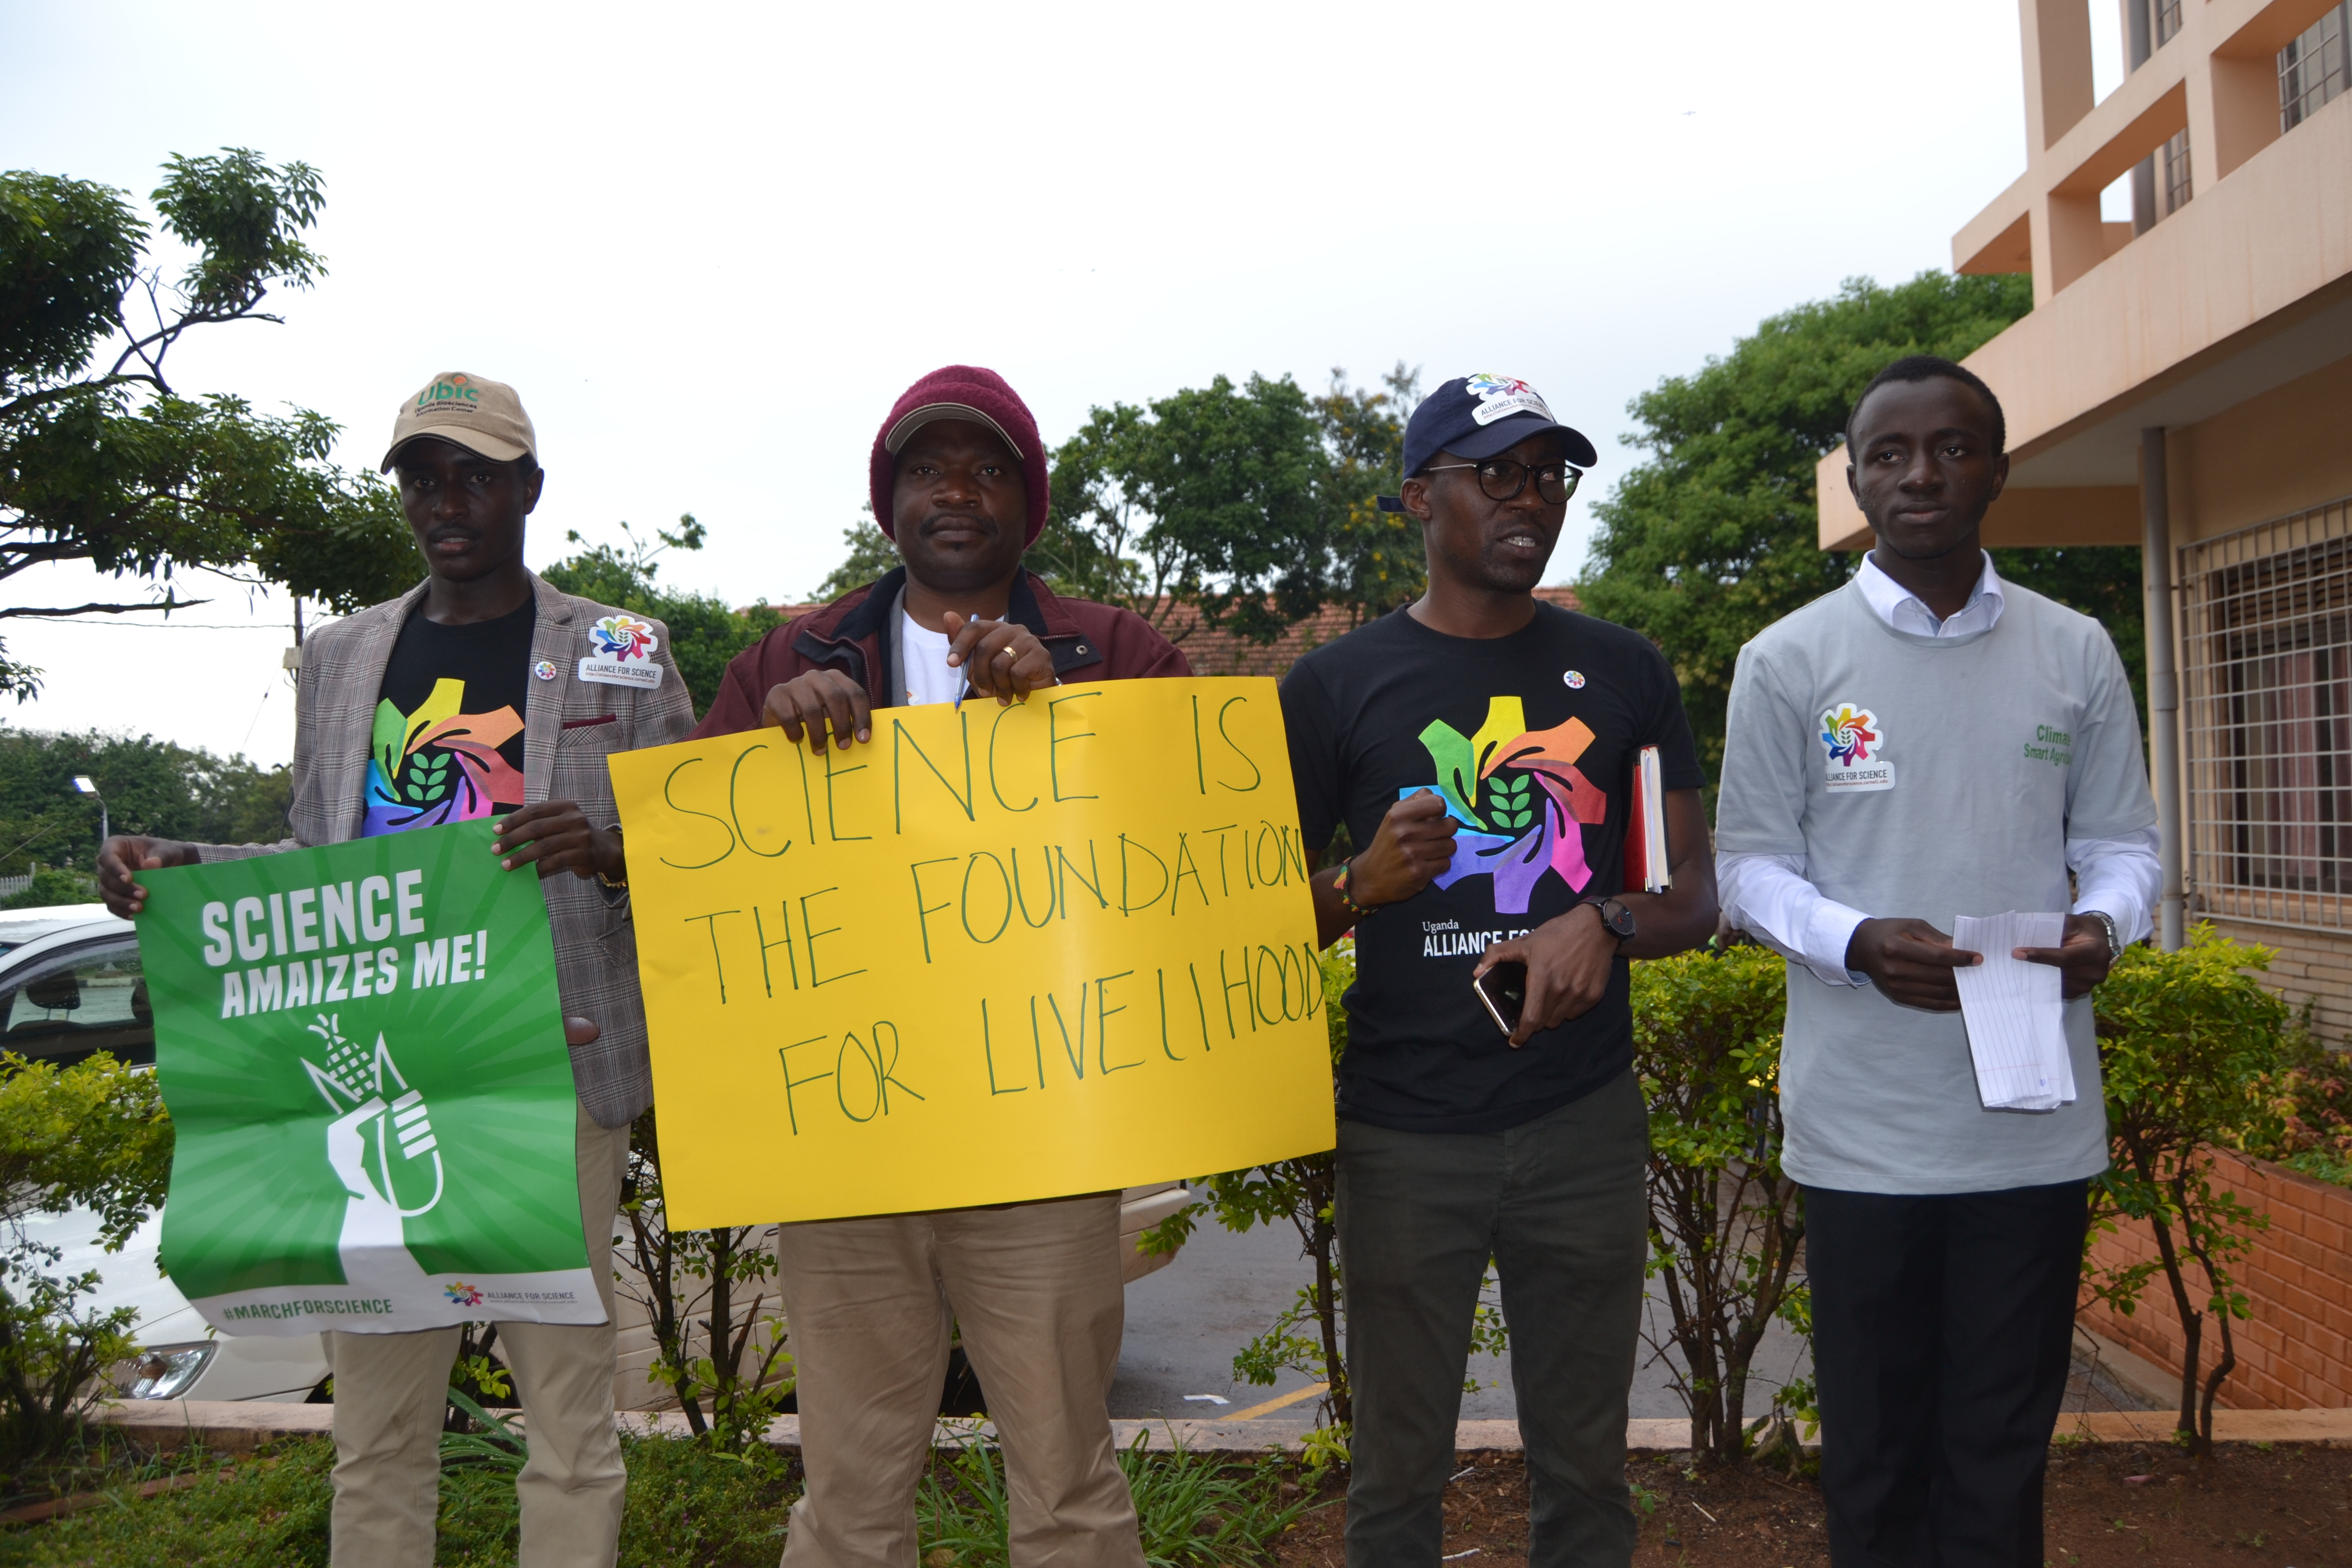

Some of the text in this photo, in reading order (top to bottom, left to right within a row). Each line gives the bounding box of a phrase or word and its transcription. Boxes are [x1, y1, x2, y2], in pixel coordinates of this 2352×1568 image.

[436, 400, 477, 409] Biosciences
[1481, 401, 1512, 415] ALLIANCE
[1527, 398, 1548, 412] SCIEN
[586, 664, 656, 678] ALLIANCE FOR SCIENCE
[2037, 724, 2071, 747] Climae
[2024, 743, 2049, 761] Smart
[660, 691, 1262, 870] SCIENCE IS
[1825, 769, 1888, 781] ALLIANCE FOR SCIENCE
[203, 869, 425, 967] SCIENCE
[685, 820, 1306, 1004] THE FOUNDATION
[1422, 919, 1460, 934] Uganda
[1423, 930, 1503, 957] ALLIANCE
[222, 929, 487, 1018] AMAIZES ME!
[778, 942, 1326, 1135] FOR LIVELIHOOD
[542, 1292, 576, 1300] SCIENCE
[223, 1299, 394, 1320] #MARCHFORSCIENCE
